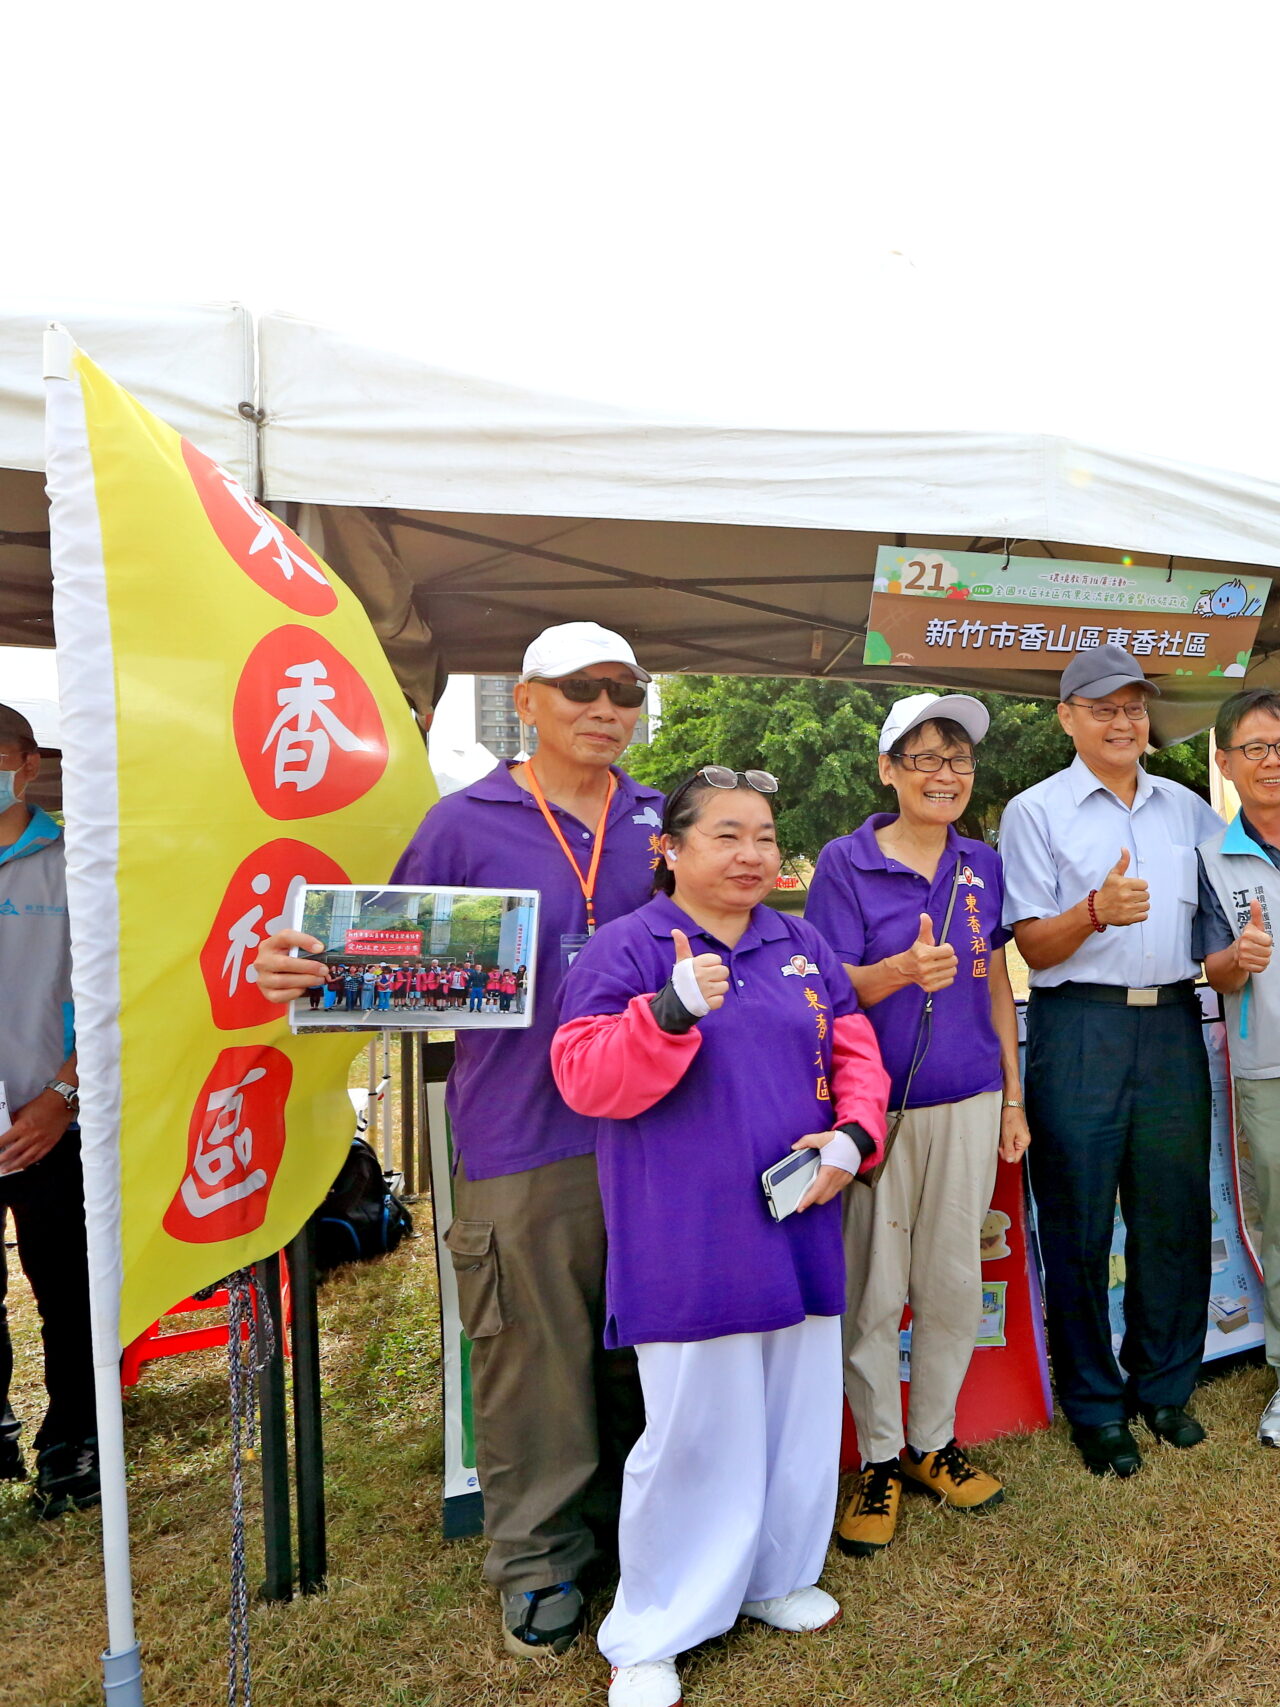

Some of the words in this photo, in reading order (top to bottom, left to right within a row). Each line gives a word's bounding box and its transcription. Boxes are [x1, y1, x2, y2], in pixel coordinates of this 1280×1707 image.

[904, 561, 945, 591] 21
[925, 617, 1211, 659] 新竹市香山區東香社區
[964, 893, 988, 977] 東香社區
